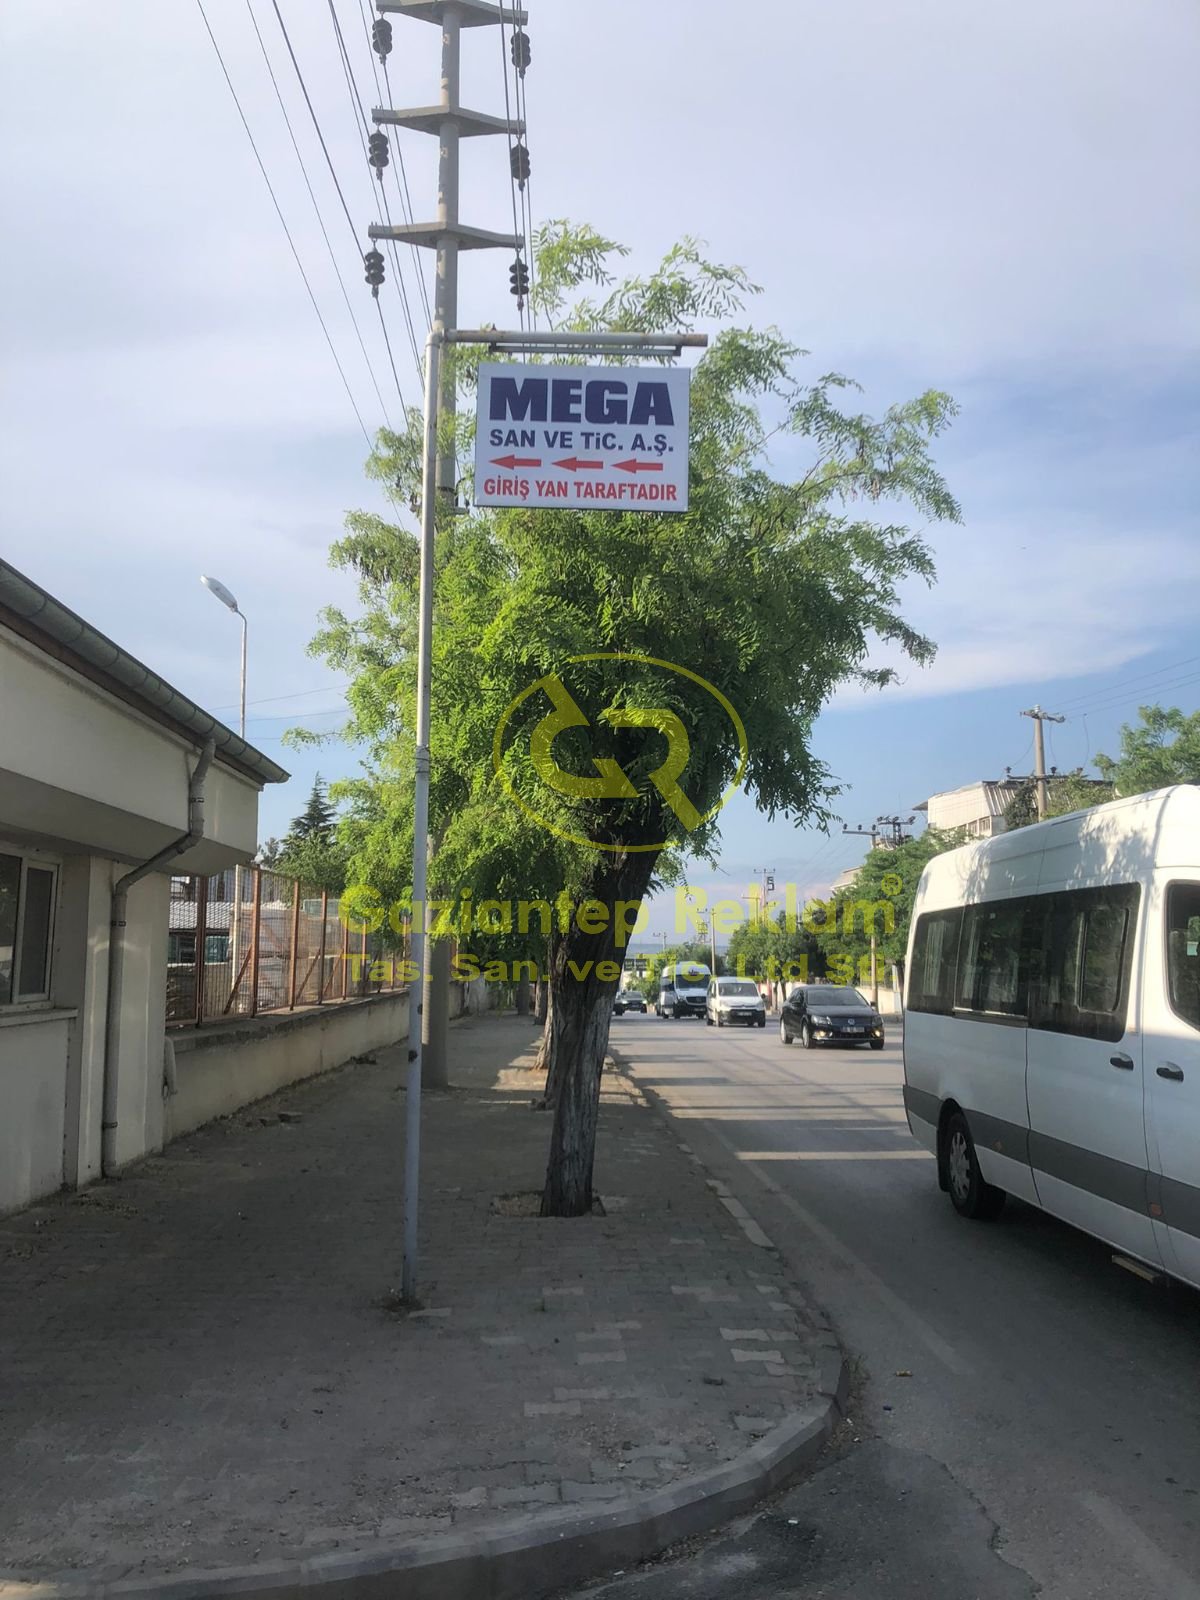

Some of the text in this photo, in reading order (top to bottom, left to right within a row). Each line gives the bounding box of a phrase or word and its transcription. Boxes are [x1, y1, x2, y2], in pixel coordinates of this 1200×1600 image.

[489, 377, 674, 425] MEGA
[489, 428, 535, 448] SAN
[544, 431, 573, 449] VE
[631, 434, 674, 457] A.Ş.
[484, 475, 677, 501] GİRİŞ YAN TARAFTADIR
